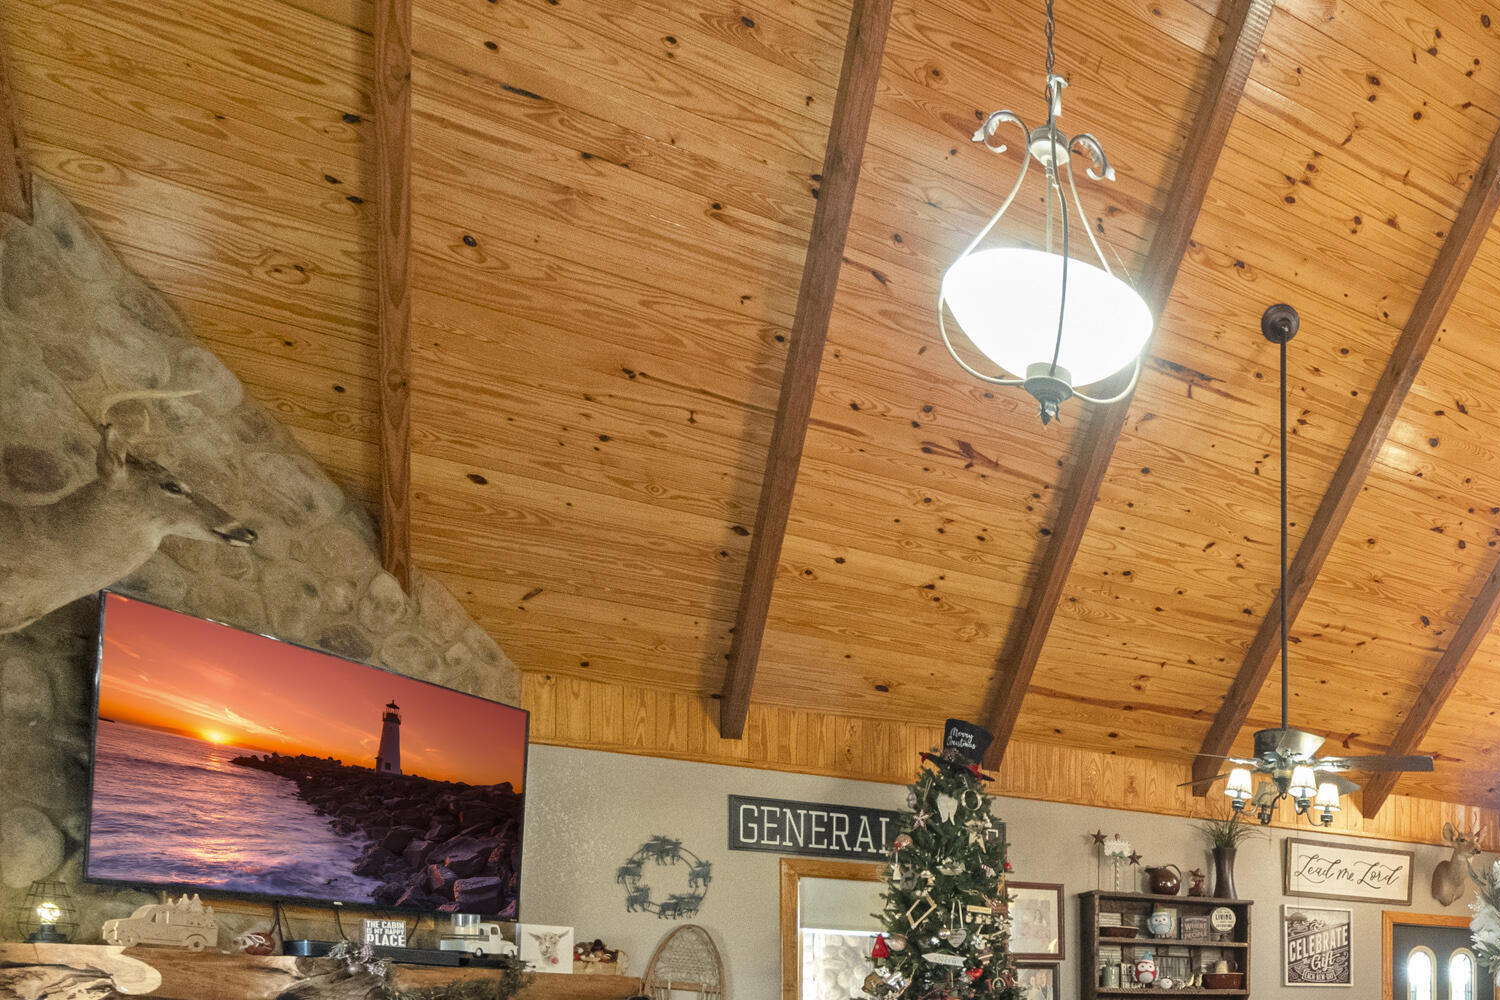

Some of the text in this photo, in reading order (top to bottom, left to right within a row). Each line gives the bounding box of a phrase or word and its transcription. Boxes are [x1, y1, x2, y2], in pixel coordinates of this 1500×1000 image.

[1295, 854, 1342, 884] Lead
[1353, 862, 1403, 889] Lord
[367, 920, 405, 929] THE CABIN
[367, 934, 406, 947] PLACE
[1289, 925, 1348, 962] CELEBRATE
[1311, 951, 1340, 971] Gift
